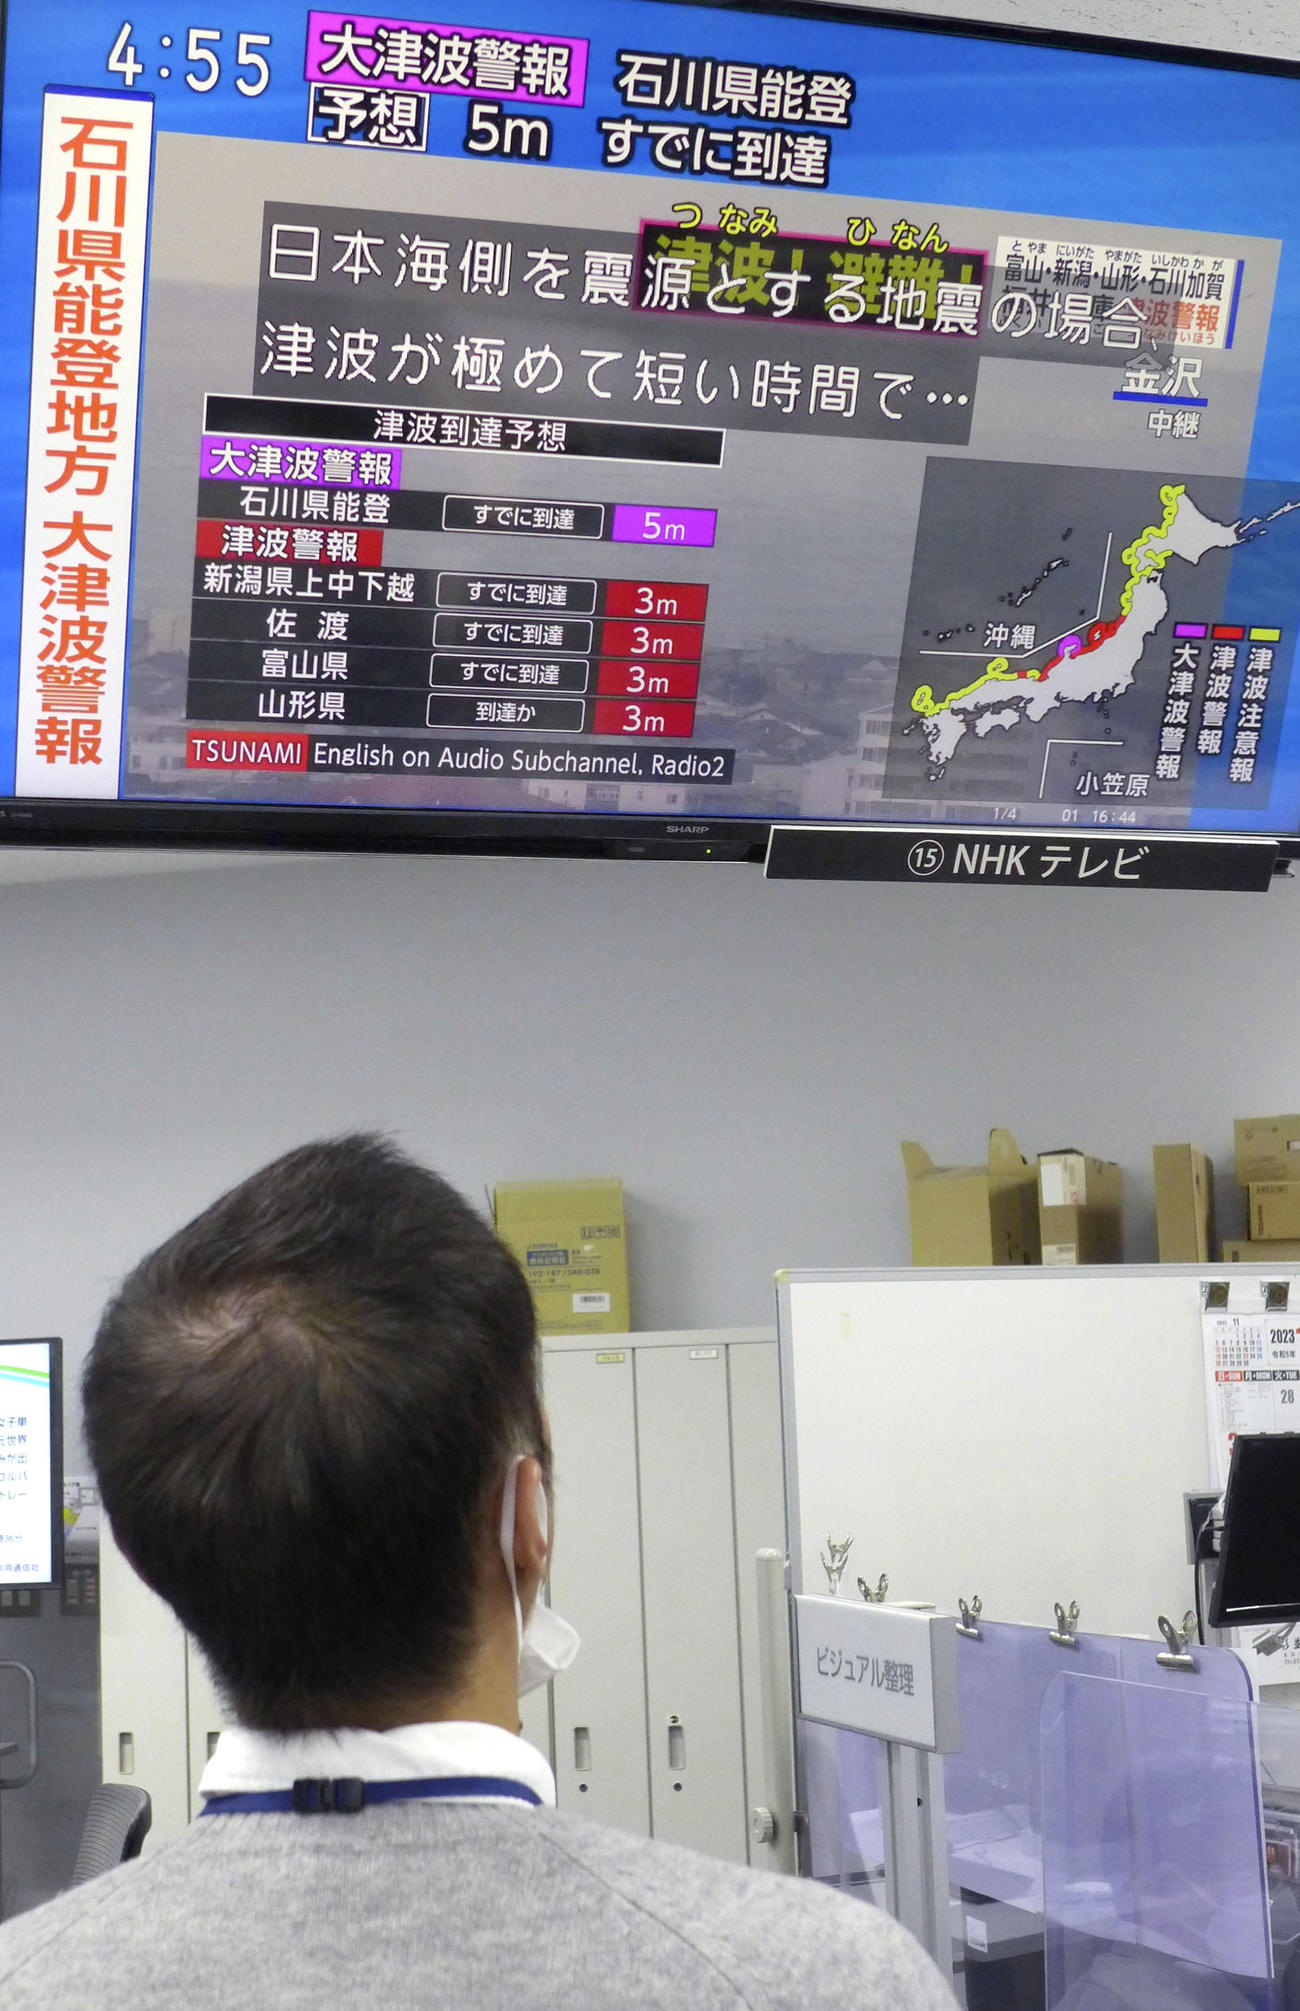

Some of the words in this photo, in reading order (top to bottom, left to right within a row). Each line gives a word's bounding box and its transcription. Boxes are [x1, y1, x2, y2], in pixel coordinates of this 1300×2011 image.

[108, 22, 271, 96] 4:55
[320, 23, 569, 97] 大津波警報
[618, 53, 853, 126] 石川県能登
[318, 88, 419, 146] 予想
[466, 104, 549, 156] 5m
[602, 119, 828, 185] すでに到達
[43, 115, 134, 497] 石川県能登地方
[1122, 353, 1201, 398] 金沢
[373, 408, 567, 453] 津波到達予想
[1147, 409, 1200, 439] 中継
[209, 440, 393, 487] 大津波警報
[239, 486, 391, 525] 石川県能登
[473, 504, 574, 532] すでに到達
[643, 511, 686, 541] 5m
[220, 524, 359, 563] 津波警報
[203, 563, 416, 604] 新潟県上中下越
[467, 579, 568, 607] すでに到達
[635, 587, 678, 616] 3m
[34, 510, 113, 766] 大津波警報
[463, 619, 564, 647] すでに到達
[631, 626, 674, 656] 3m
[983, 622, 1037, 650] 沖縄
[261, 647, 349, 681] 富山県
[460, 659, 561, 687] すでに到達
[626, 665, 670, 695] 3m
[257, 688, 346, 721] 山形県
[475, 700, 536, 724] 到達か
[1155, 642, 1199, 779] 大津波警報
[1197, 644, 1237, 754] 津波警報
[1228, 647, 1273, 782] 津波注意報
[622, 705, 666, 735] 3m
[192, 738, 302, 765] TSUNAMI
[315, 741, 394, 773] English
[402, 750, 430, 768] on
[439, 745, 504, 770] Audio
[651, 755, 725, 778] Radio2
[1076, 771, 1150, 797] 小笠原
[666, 825, 710, 833] SHARP
[993, 807, 1017, 820] 1/4
[1062, 808, 1078, 822] 01
[1092, 809, 1136, 823] 16:44
[953, 843, 1031, 876] NHK
[1040, 846, 1150, 880] テレビ
[1270, 1328, 1295, 1344] 2023
[1281, 1389, 1294, 1404] 28
[816, 1646, 914, 1696] ビジュアル整理
